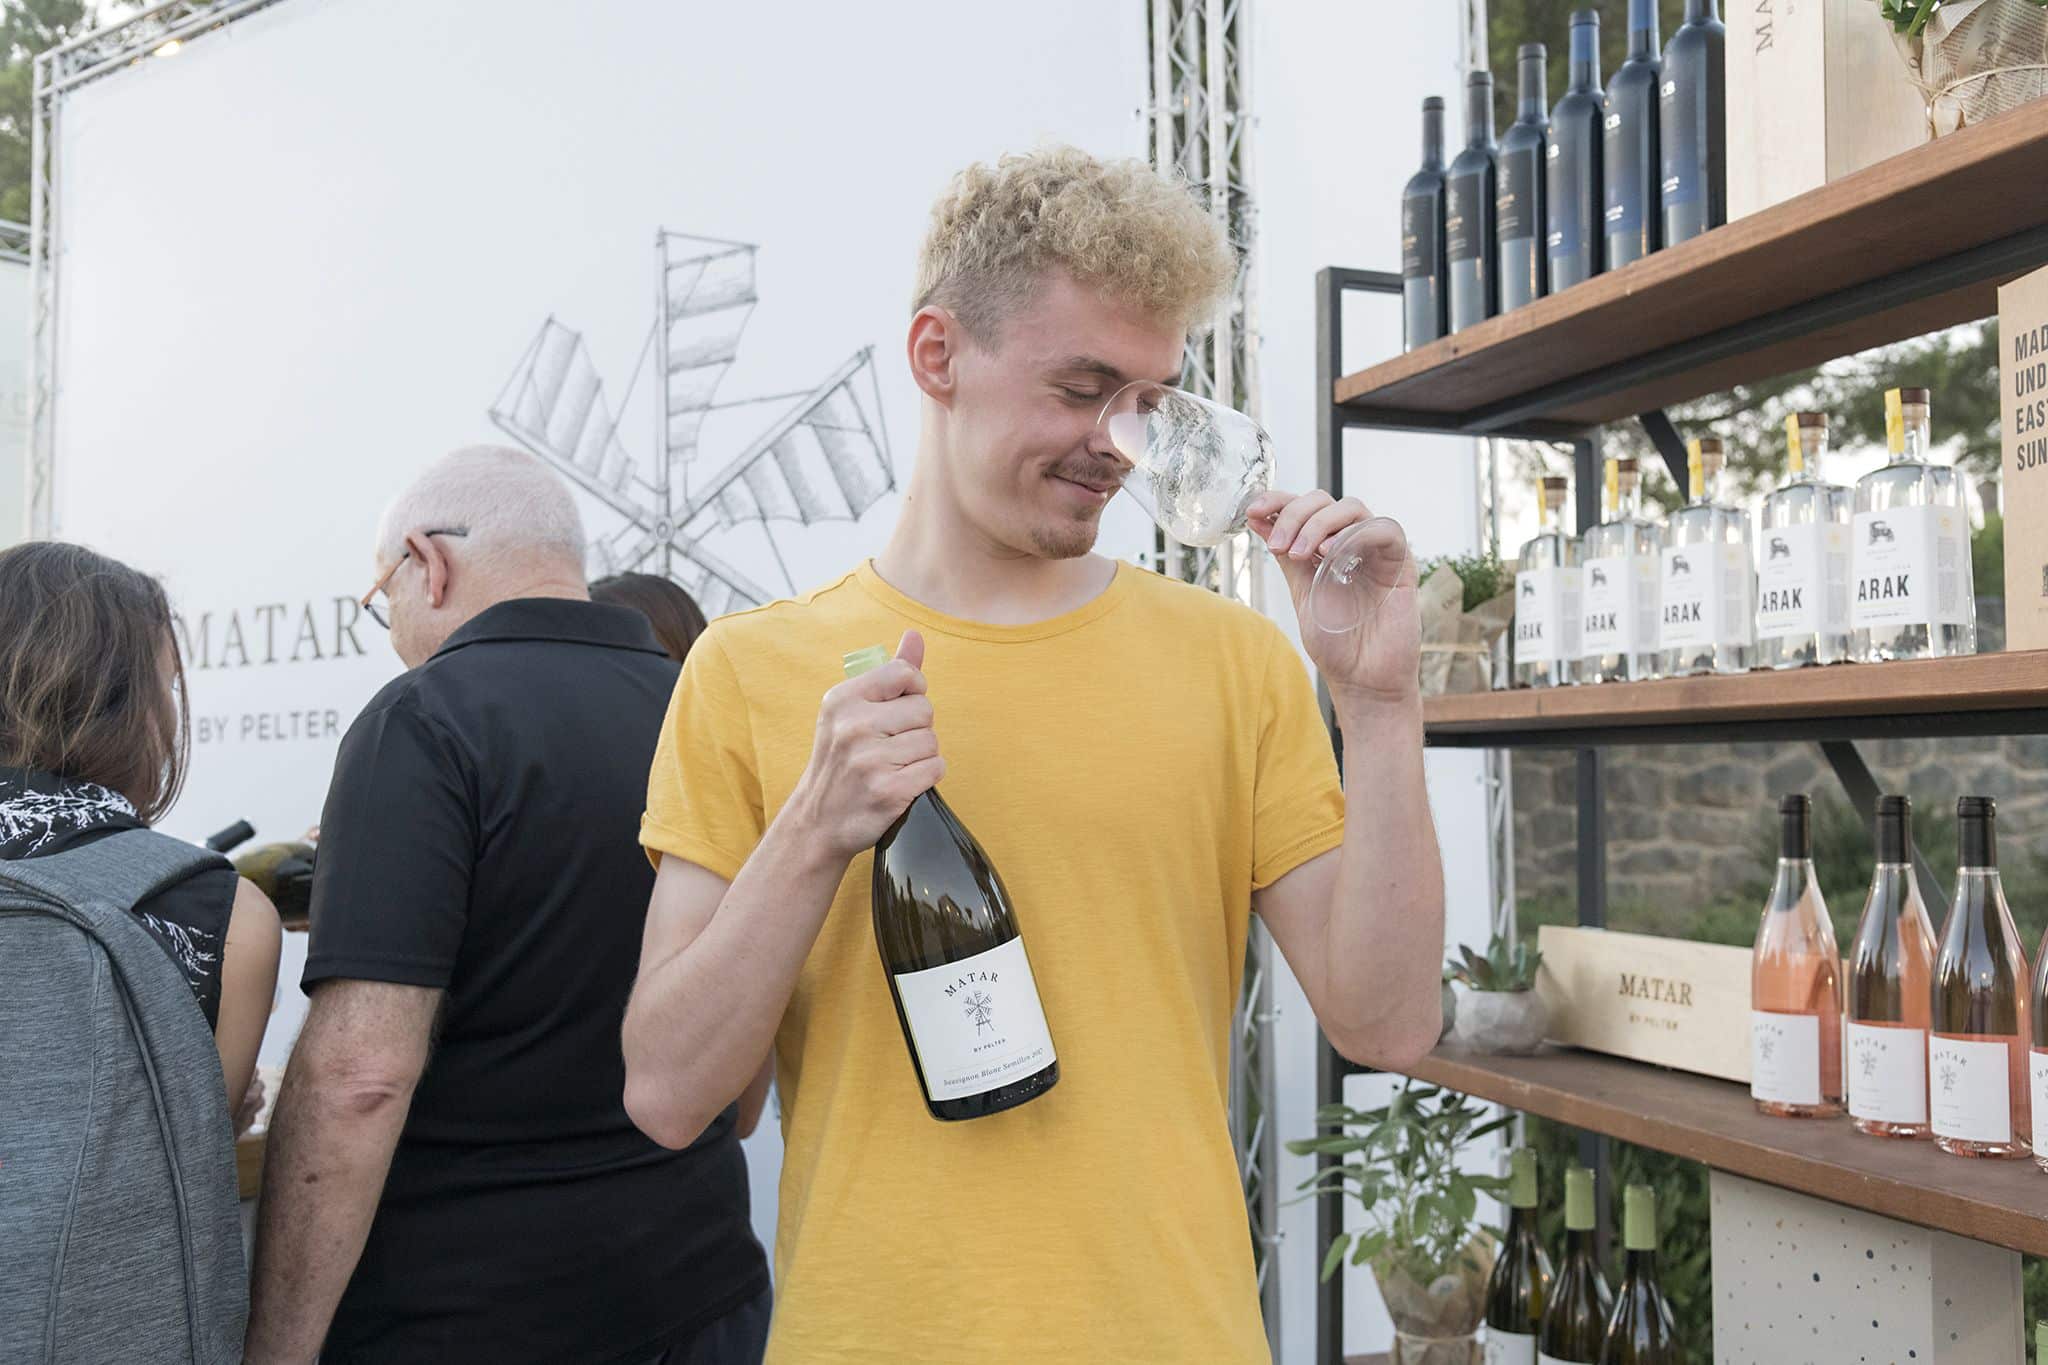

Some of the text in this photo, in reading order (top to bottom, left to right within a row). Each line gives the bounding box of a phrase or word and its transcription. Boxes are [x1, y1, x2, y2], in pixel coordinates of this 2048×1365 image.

[2015, 362, 2047, 398] UND
[2016, 398, 2048, 435] EAS
[2017, 437, 2048, 471] SUN
[1762, 587, 1803, 613] ARAK
[1858, 574, 1909, 602] ARAK
[1586, 613, 1617, 634] ARAK
[1664, 601, 1702, 625] ARAK
[174, 595, 367, 669] MATAR
[197, 709, 340, 744] BY PELTER
[944, 971, 998, 997] MATAR
[1619, 972, 1693, 1007] MATAR
